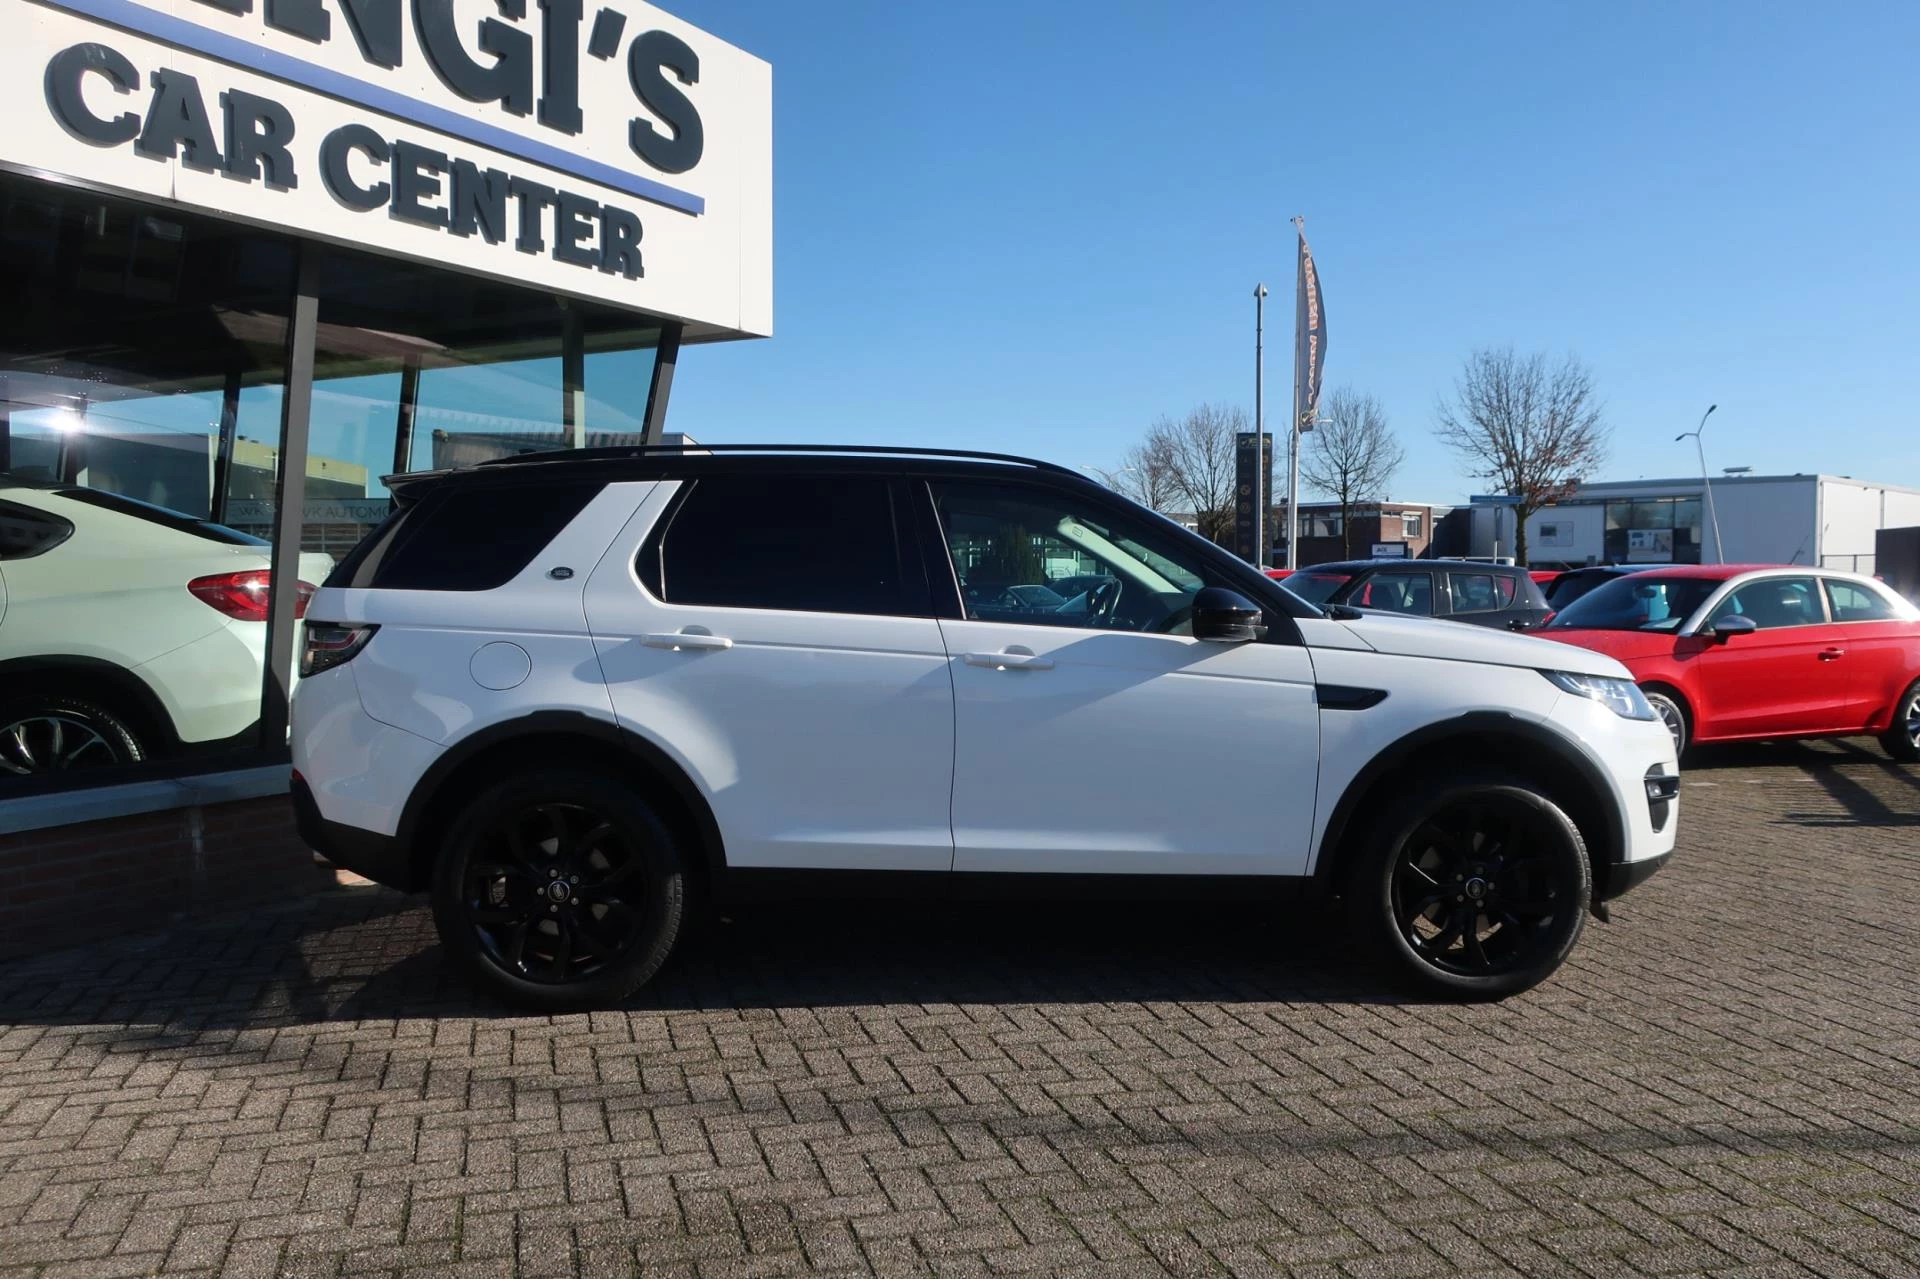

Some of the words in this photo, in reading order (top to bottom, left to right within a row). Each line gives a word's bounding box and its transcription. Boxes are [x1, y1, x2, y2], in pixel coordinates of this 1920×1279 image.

[44, 42, 297, 192] CAR
[319, 123, 644, 281] CENTER
[190, 0, 704, 174] GI'S
